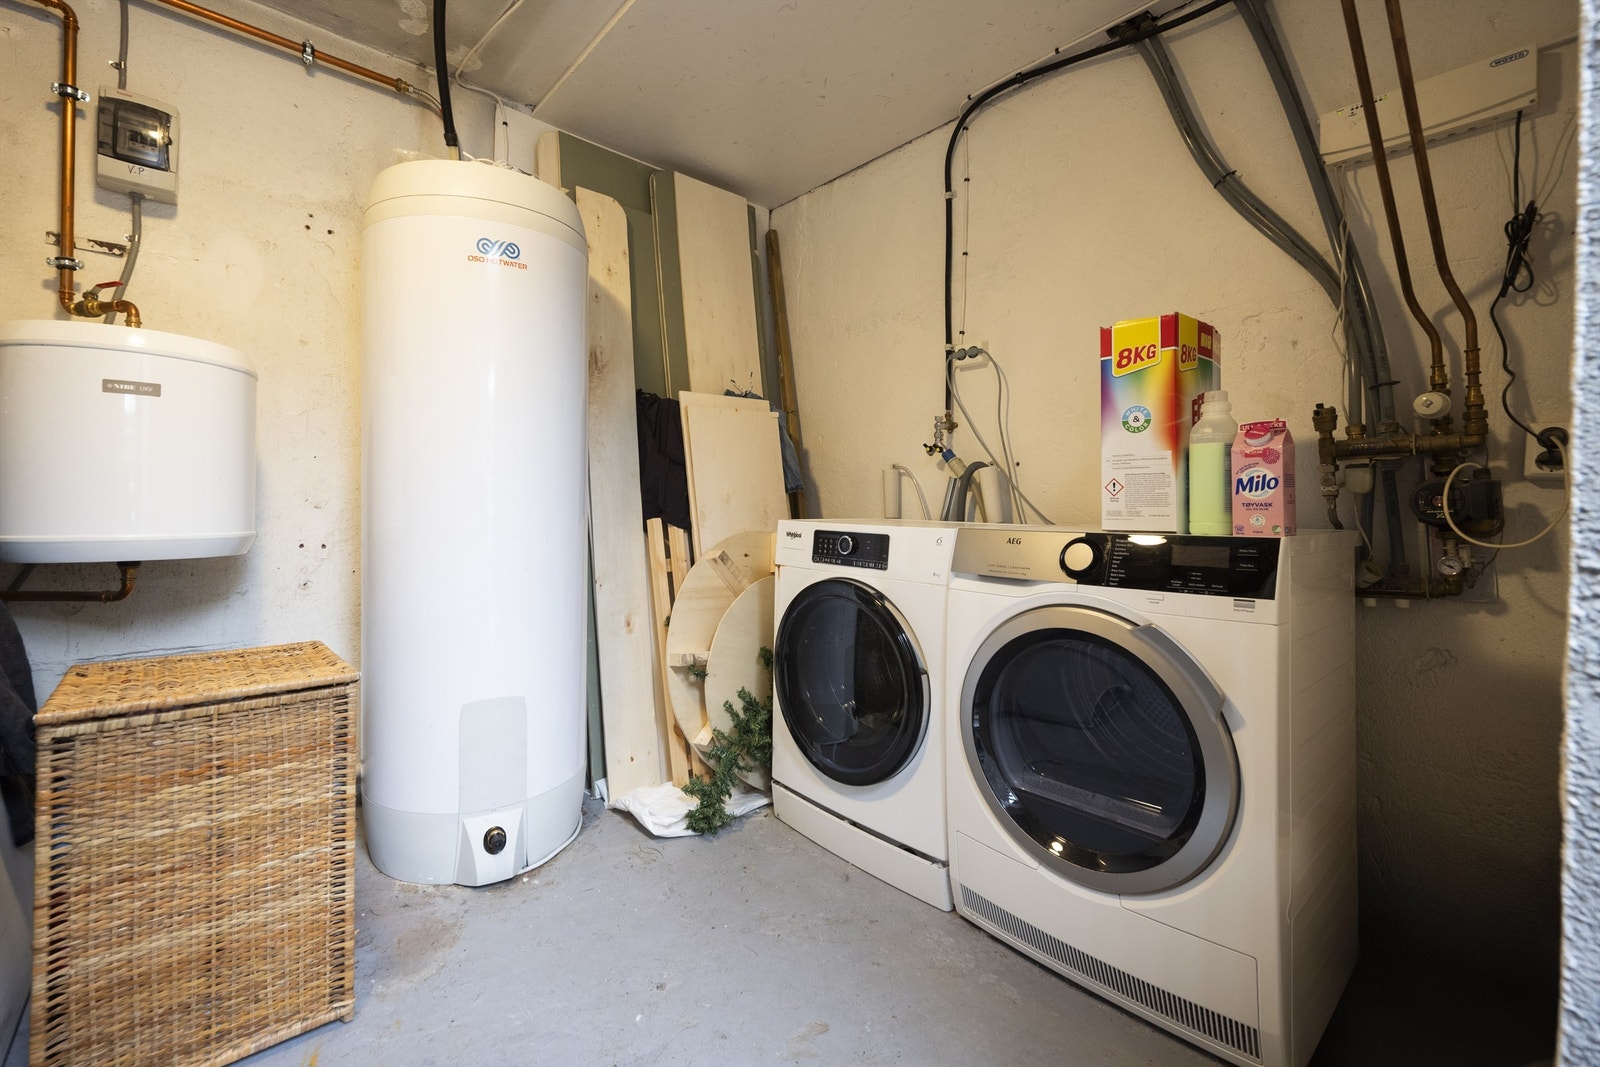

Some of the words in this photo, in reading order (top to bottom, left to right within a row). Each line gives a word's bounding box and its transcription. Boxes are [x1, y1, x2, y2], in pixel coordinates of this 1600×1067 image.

[467, 255, 485, 263] OSO
[1116, 343, 1157, 369] 8KG
[1180, 344, 1197, 364] 8KG
[1125, 405, 1149, 416] WHITE
[1132, 415, 1140, 423] &
[1124, 421, 1149, 433] COLOR
[1235, 473, 1279, 495] Milo
[786, 531, 802, 539] Whirlpool
[1006, 537, 1022, 545] AEG
